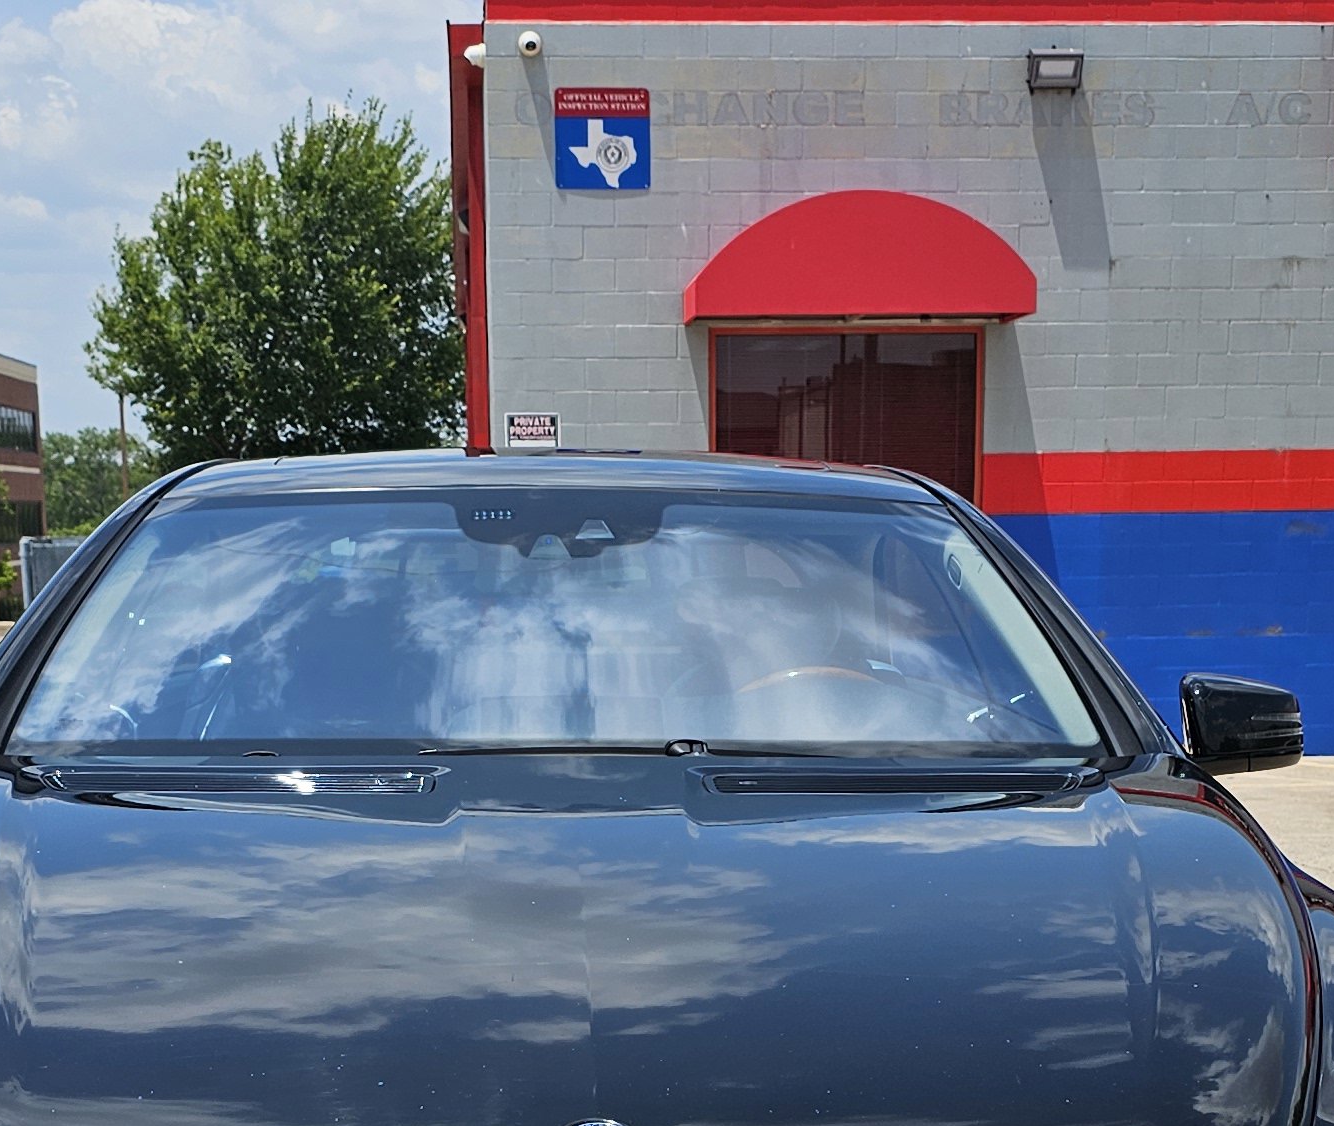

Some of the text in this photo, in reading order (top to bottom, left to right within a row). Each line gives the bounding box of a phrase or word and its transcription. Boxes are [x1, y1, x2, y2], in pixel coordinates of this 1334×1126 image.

[563, 93, 641, 101] OFFICIAL VEHICLE
[558, 102, 646, 110] INSPECTION STATION
[513, 416, 551, 426] PRIVATE
[509, 426, 555, 436] PROPERTY
